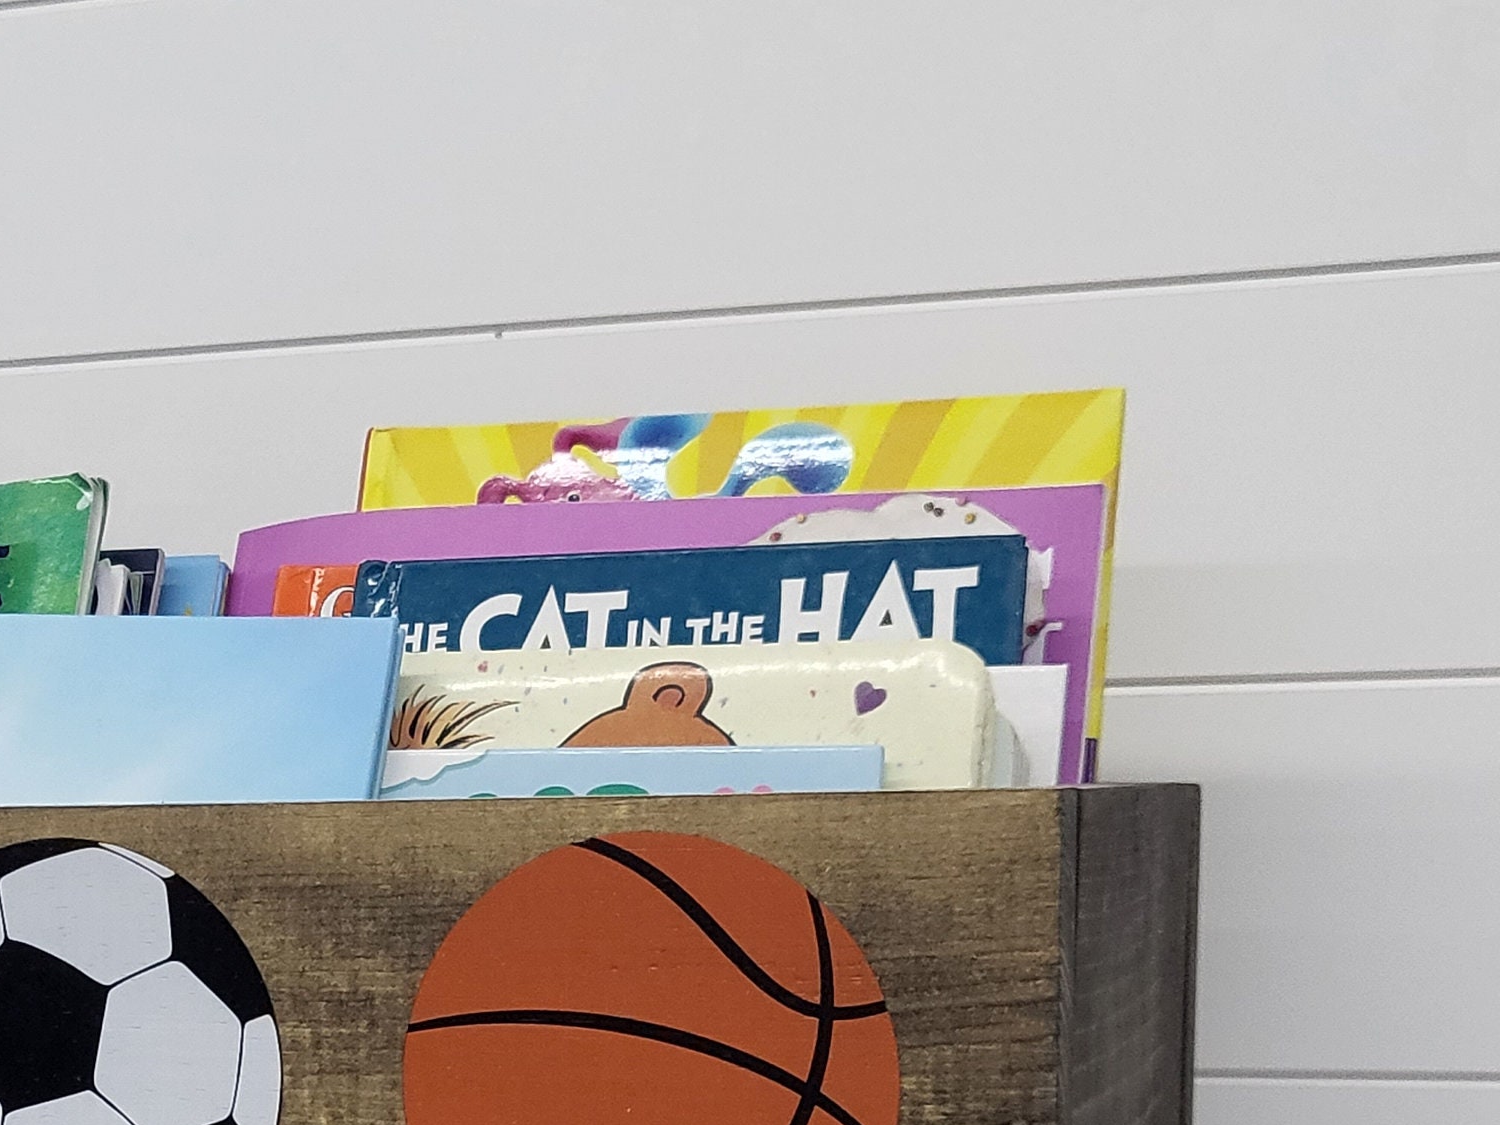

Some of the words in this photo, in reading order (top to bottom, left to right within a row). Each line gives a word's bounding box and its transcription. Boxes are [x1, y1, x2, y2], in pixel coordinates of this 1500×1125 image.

[402, 621, 448, 653] HE
[459, 584, 630, 651] CAT
[626, 616, 672, 648] IN
[685, 611, 765, 646] THE
[779, 558, 981, 645] HAT
